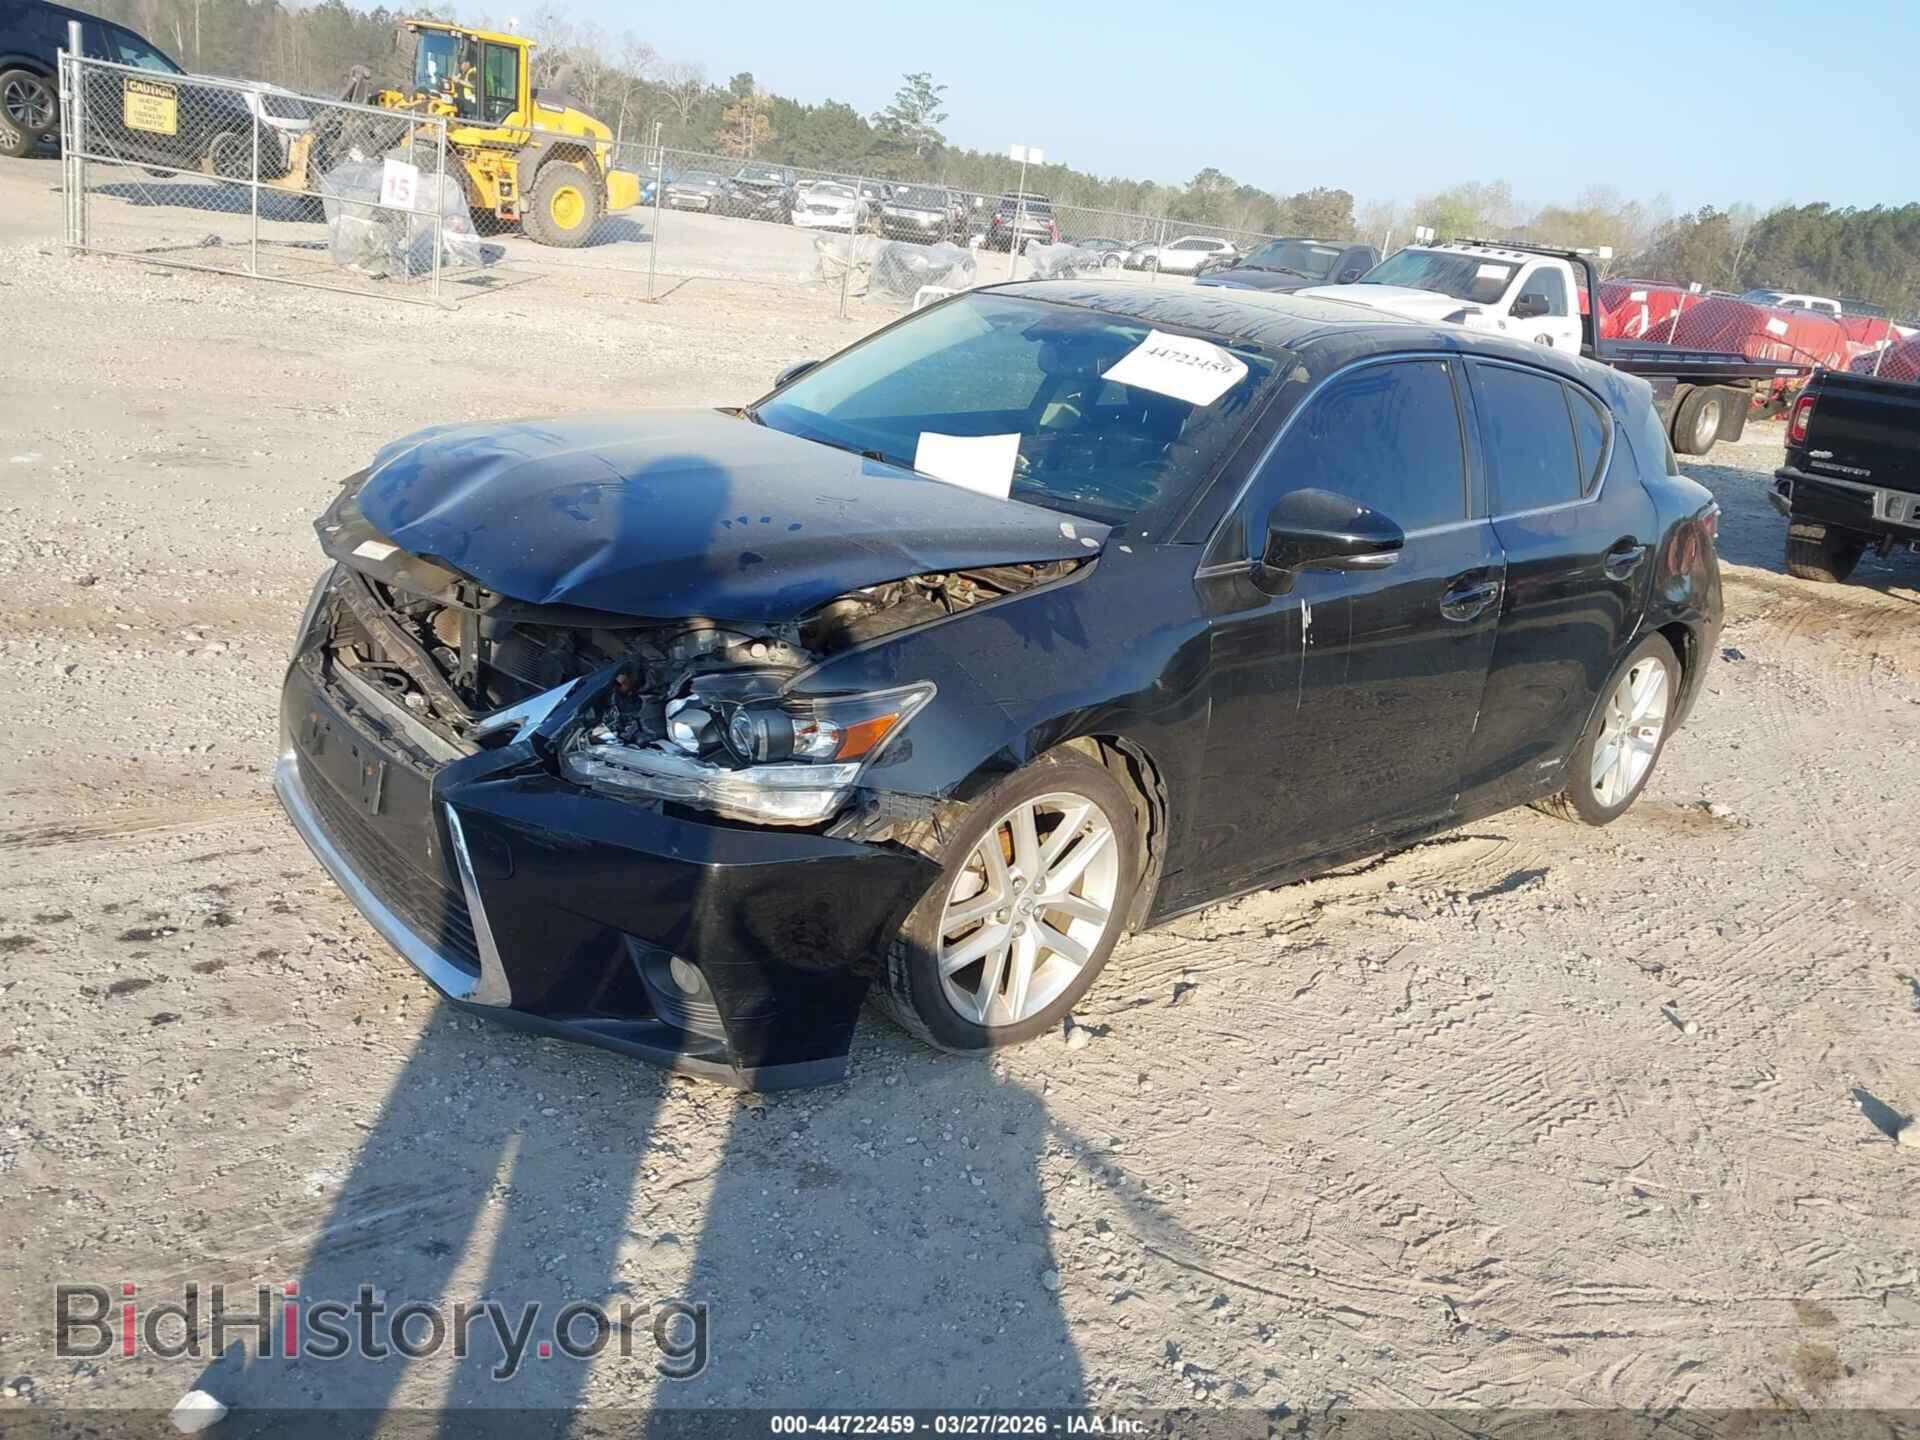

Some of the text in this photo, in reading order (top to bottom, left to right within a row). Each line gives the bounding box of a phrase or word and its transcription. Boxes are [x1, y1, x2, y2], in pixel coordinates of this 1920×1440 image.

[128, 80, 174, 99] CAUTION
[388, 175, 410, 202] 15
[1146, 346, 1233, 374] 44722459
